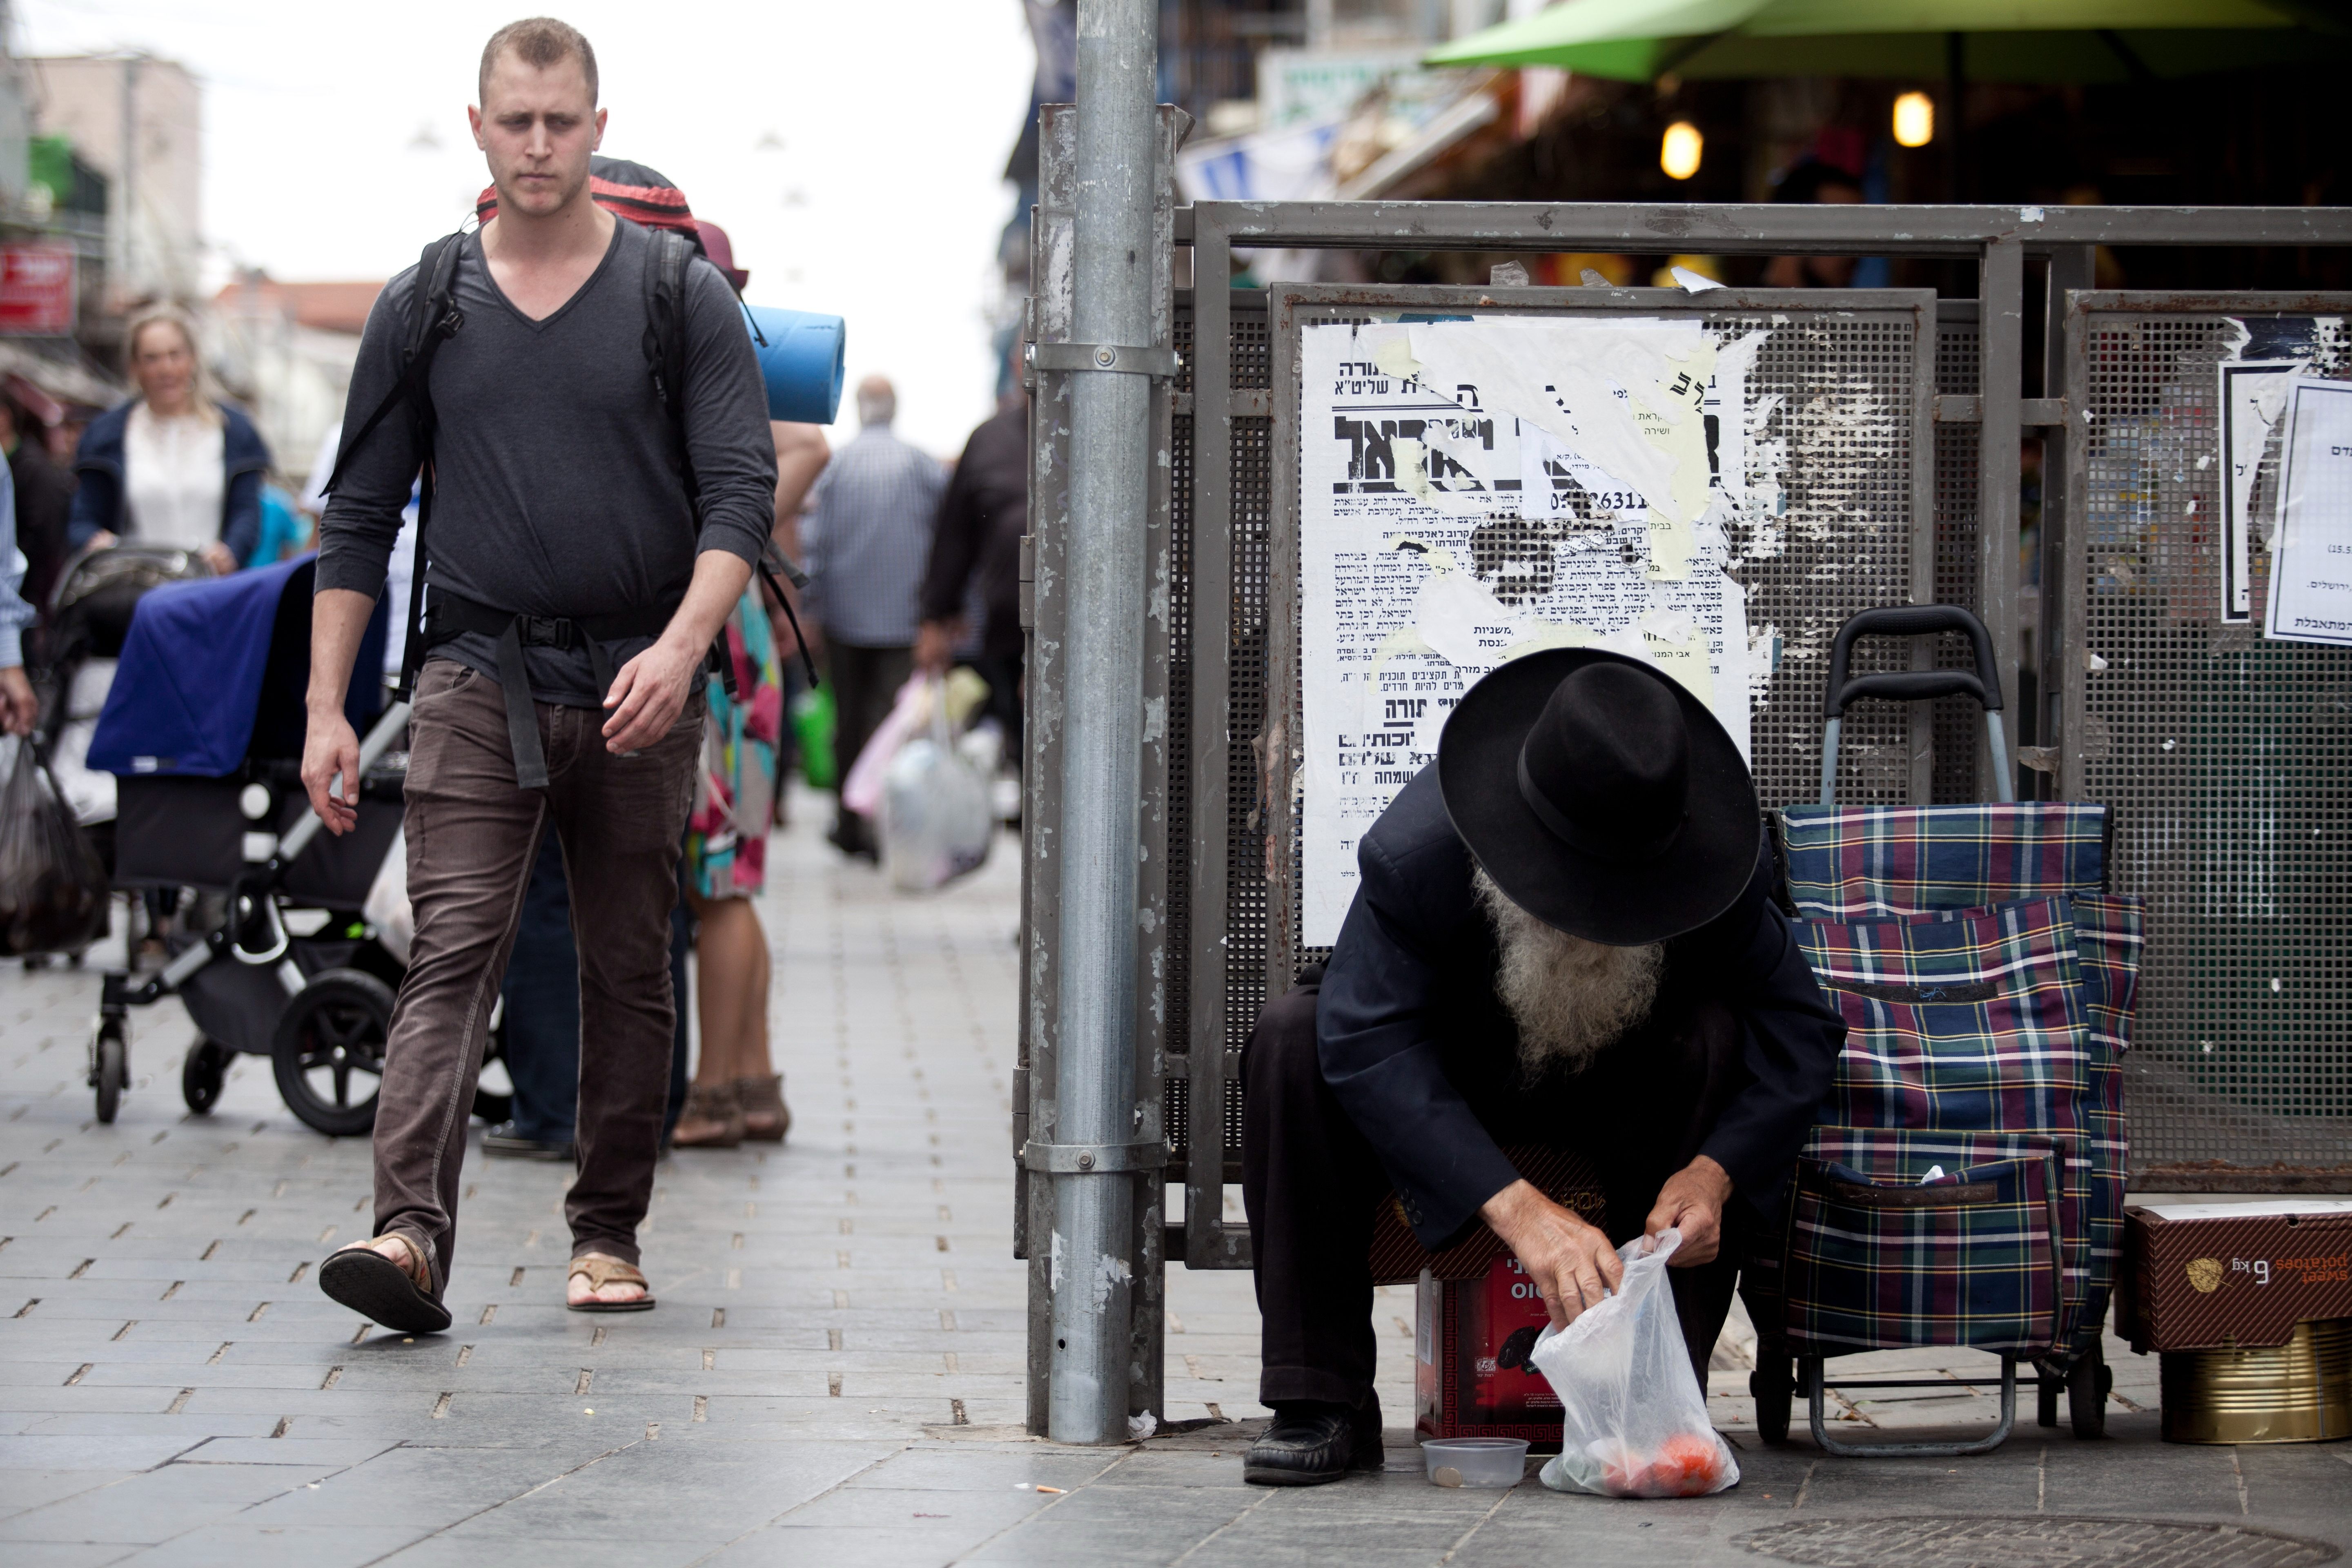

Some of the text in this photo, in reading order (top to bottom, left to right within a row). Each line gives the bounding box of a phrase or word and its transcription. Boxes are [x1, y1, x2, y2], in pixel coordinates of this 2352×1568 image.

[1335, 379, 1388, 395] שליט"א
[1373, 496, 1388, 506] לחג
[1396, 516, 1419, 525] רח"ל.
[1447, 530, 1469, 539] קרוב
[1334, 550, 1419, 562] של שמד, בצירוף
[1407, 563, 1432, 571] מבית
[1560, 557, 1597, 569] למיניהם
[1373, 564, 1401, 574] ומחוץ
[1630, 568, 1641, 579] על
[1374, 575, 1411, 584] בחינוכם
[1570, 569, 1601, 580] קהילות
[1598, 582, 1616, 590] ספר
[1621, 581, 1646, 590] בבתי
[1688, 578, 1722, 589] לכפירה
[1335, 585, 1419, 596] שכל גדולי ישראל
[1372, 597, 1383, 606] לא
[1589, 592, 1616, 602] ביטול
[1621, 593, 1650, 603] יעבור,
[1676, 592, 1695, 601] יהרג
[1700, 592, 1722, 602] פסקו
[1335, 597, 1353, 607] להם
[1388, 597, 1412, 607] רח"ל,
[1336, 608, 1412, 620] ישראל, וכן בתי
[1550, 606, 1587, 614] מפגשים
[1592, 603, 1619, 615] לערוך
[1624, 604, 1646, 615] פשע
[1570, 616, 1600, 625] ישראל
[1704, 615, 1723, 623] ספר
[1376, 621, 1405, 631] עקירת
[1379, 672, 1405, 681] תוכנית
[1412, 671, 1447, 681] תקציבים
[1380, 683, 1408, 691] חרדים.
[1415, 681, 1437, 691] להיות
[2276, 1252, 2348, 1270] potatoes
[2232, 1258, 2268, 1284] 6 kg
[2302, 1270, 2348, 1285] sweet
